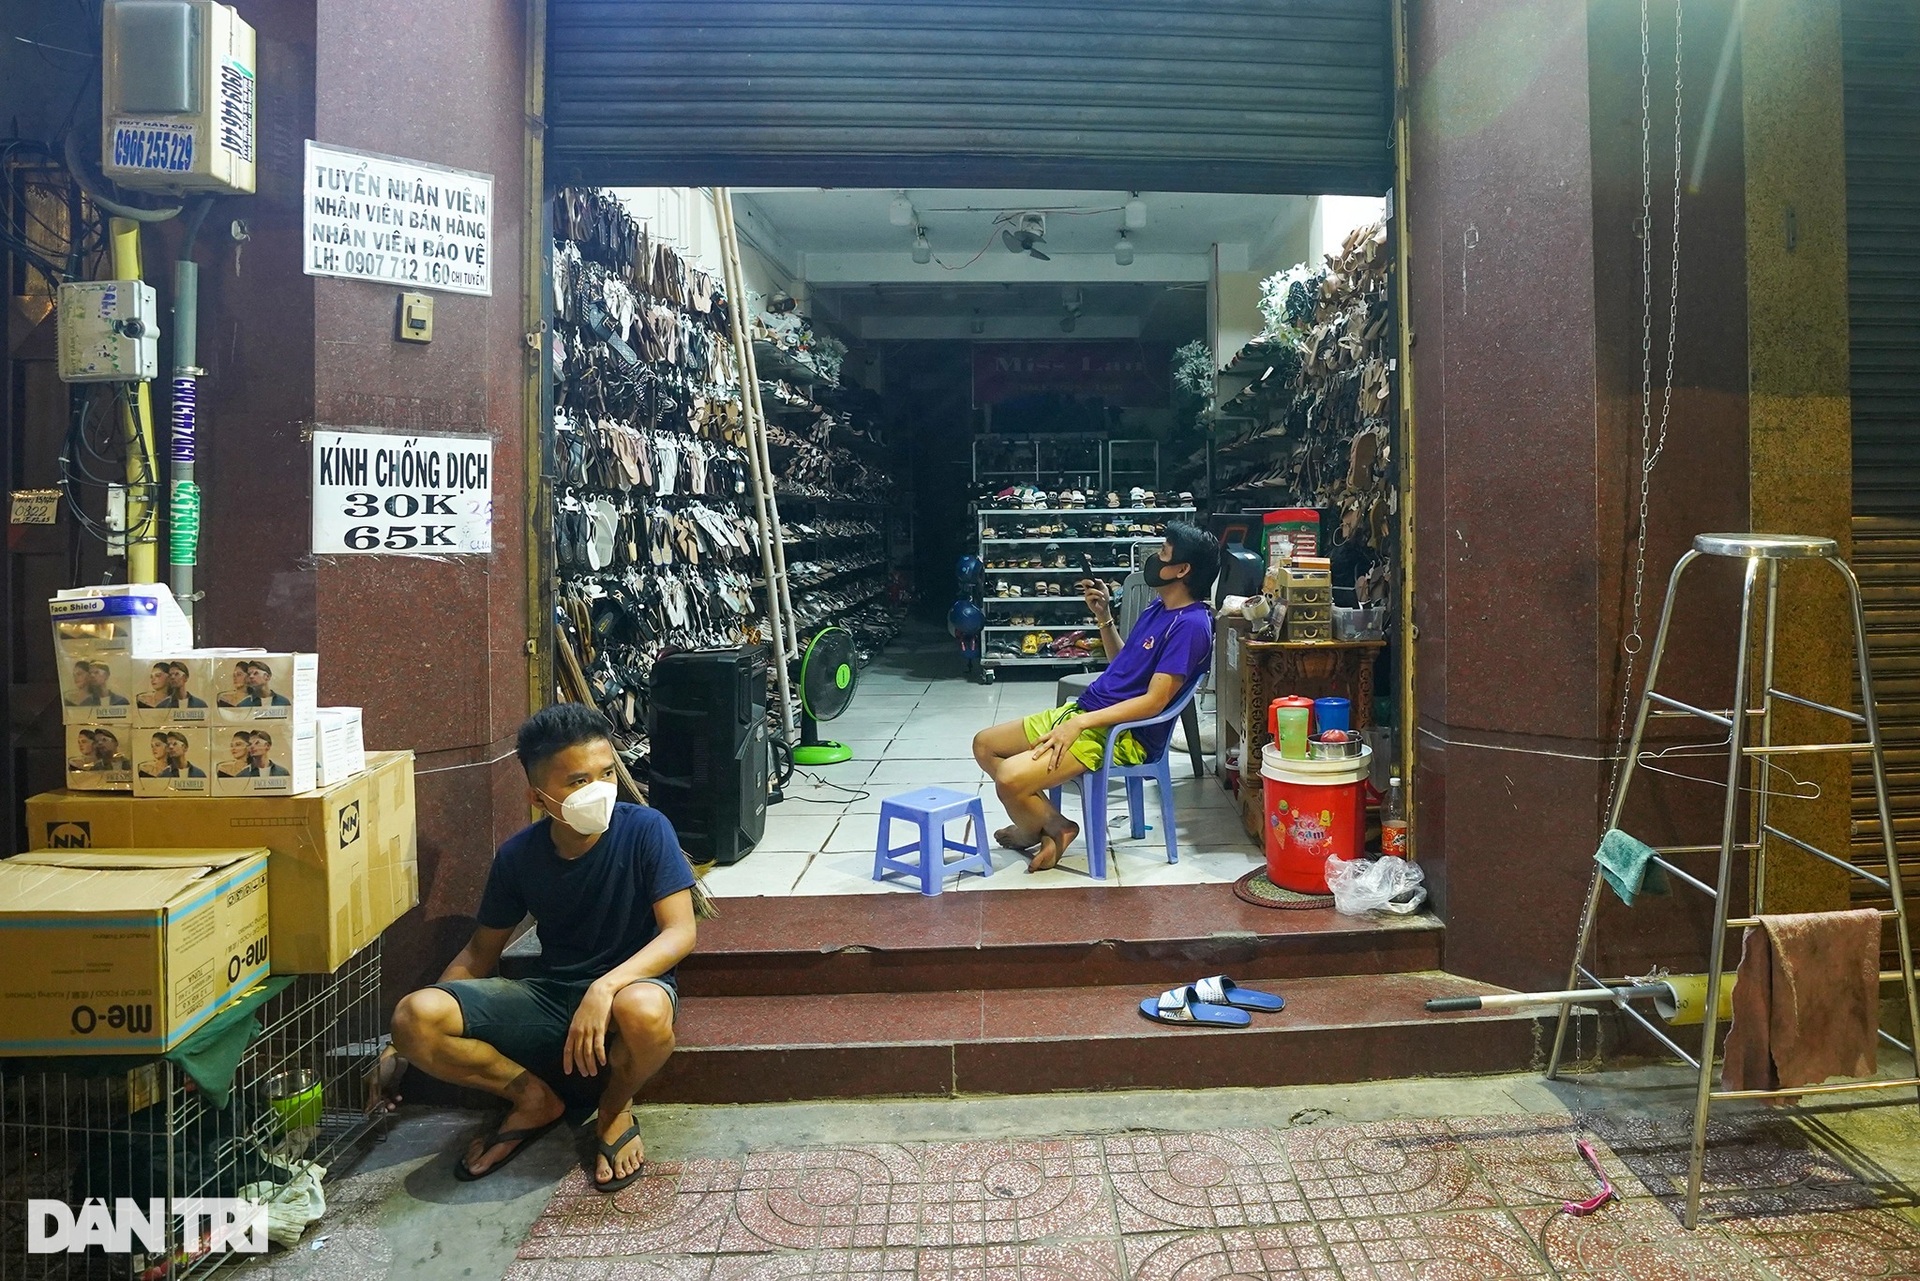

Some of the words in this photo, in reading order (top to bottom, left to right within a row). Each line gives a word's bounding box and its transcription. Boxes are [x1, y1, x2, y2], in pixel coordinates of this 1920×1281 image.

[315, 162, 380, 198] TUYỂN
[388, 178, 438, 208] NHÂN
[445, 187, 485, 216] VIÊN
[314, 195, 360, 220] NHÂN
[366, 203, 403, 226] VIÊN
[410, 209, 440, 232] BÁN
[446, 214, 486, 240] HÀNG
[312, 223, 366, 248] NHÂN
[373, 230, 416, 254] VIÊN
[423, 234, 458, 261] BẢO
[464, 243, 485, 268] VỆ
[314, 246, 339, 270] LH:
[345, 250, 384, 276] 0907
[390, 256, 418, 280] 712
[424, 262, 450, 284] 160
[995, 357, 1064, 372] Miss
[320, 437, 368, 486] KÍNH
[376, 438, 440, 488] CHỐNG
[447, 452, 488, 494] DỊCH
[344, 493, 458, 518] 30K
[344, 526, 456, 550] 65K
[70, 602, 98, 611] Shield
[342, 813, 357, 836] NN
[54, 834, 86, 848] NN
